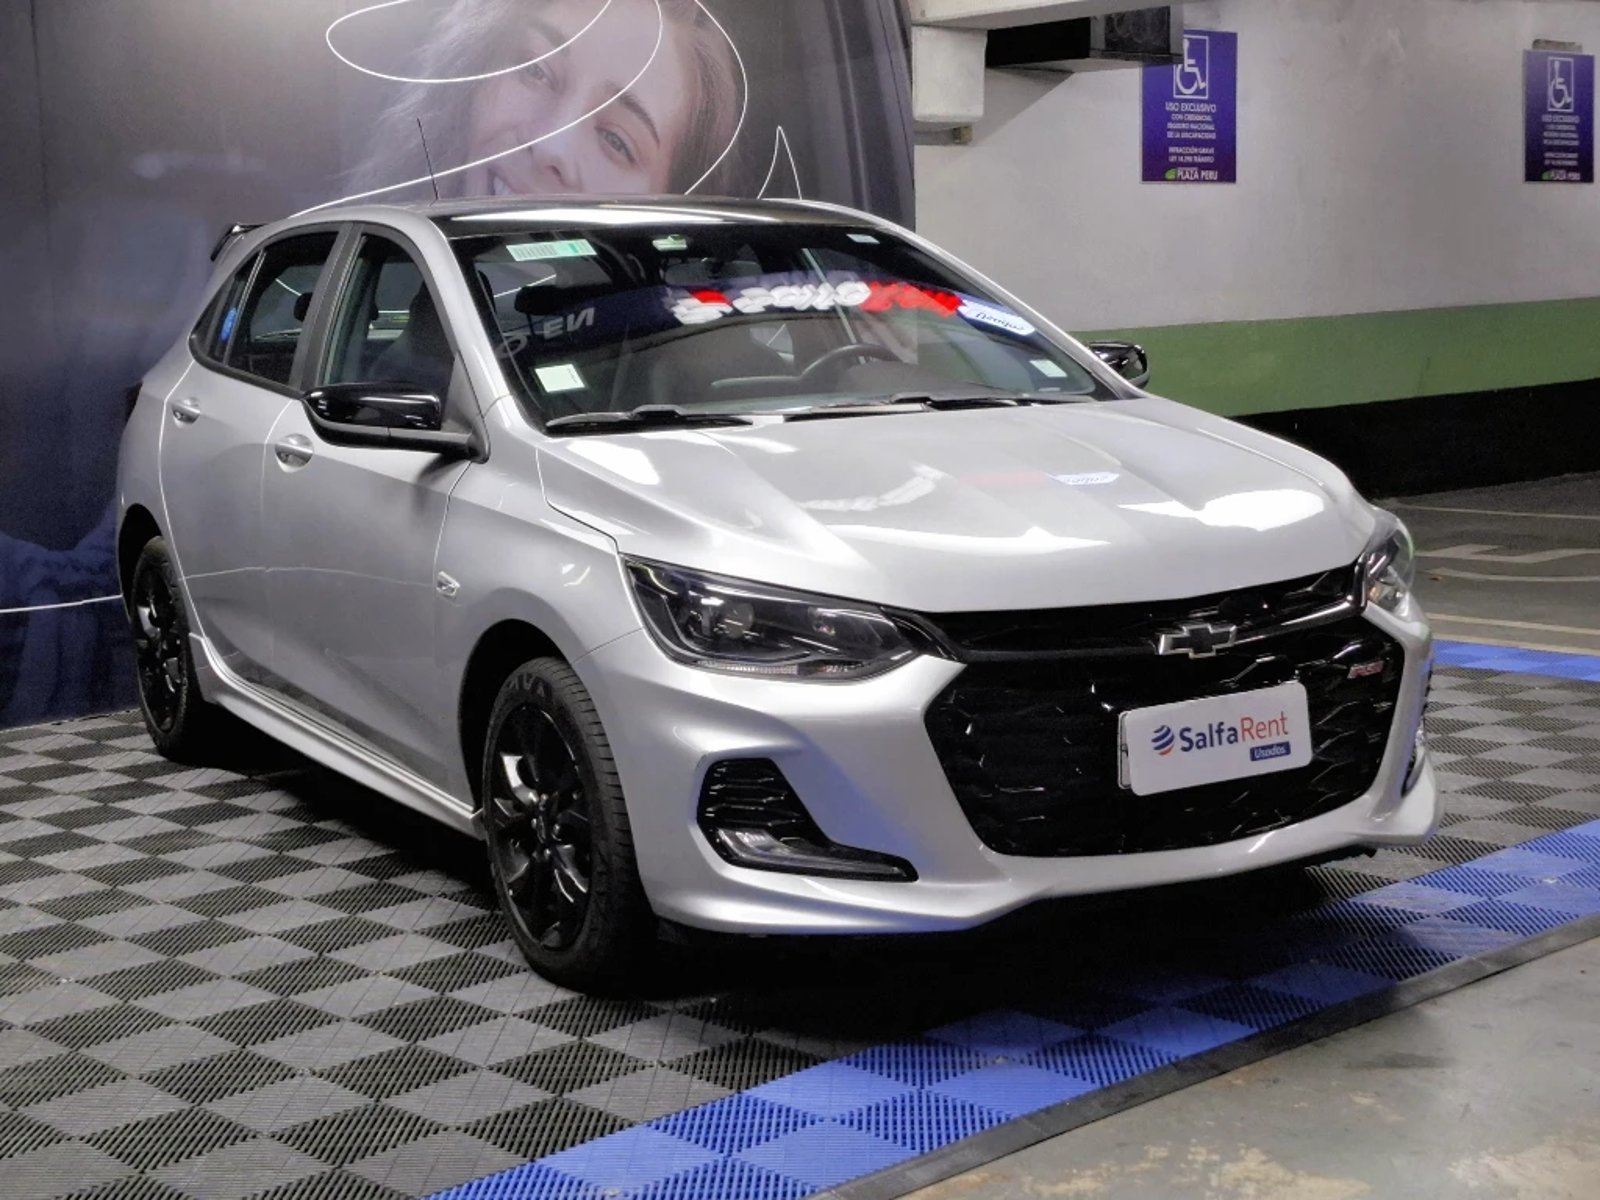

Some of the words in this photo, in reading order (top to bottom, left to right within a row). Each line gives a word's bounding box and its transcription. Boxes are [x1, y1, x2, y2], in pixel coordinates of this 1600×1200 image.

[1181, 102, 1217, 113] EXCLUSIVO
[1177, 169, 1200, 181] PLAZA
[1179, 711, 1290, 753] SalfaRent
[1253, 744, 1288, 760] Usados
